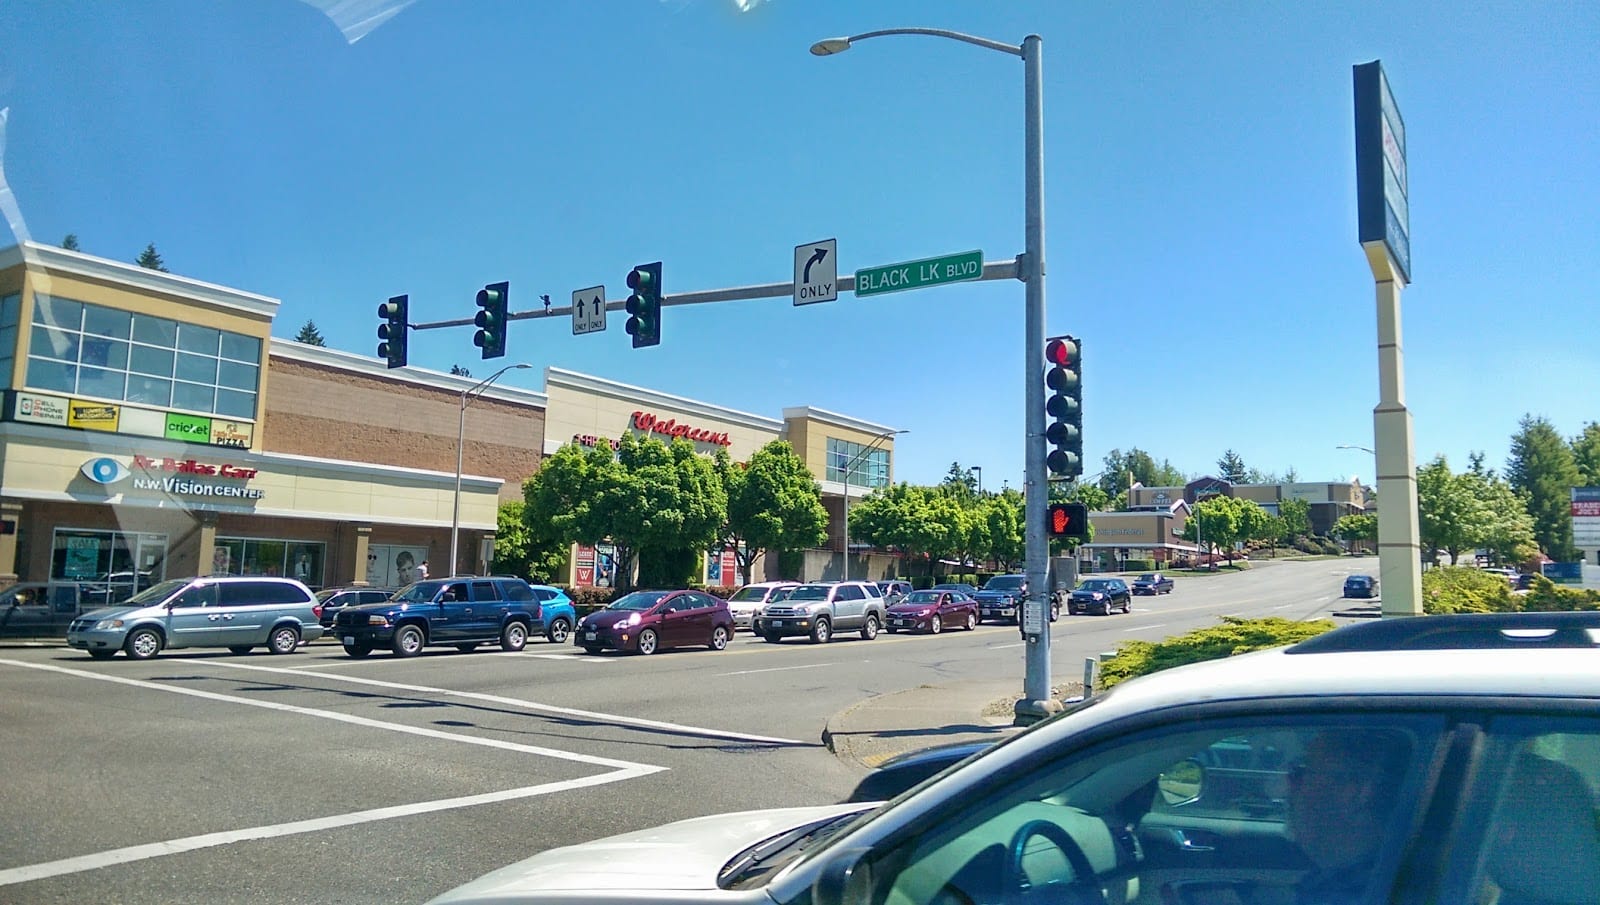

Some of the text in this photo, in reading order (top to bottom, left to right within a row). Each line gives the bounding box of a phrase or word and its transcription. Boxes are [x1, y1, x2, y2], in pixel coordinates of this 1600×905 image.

[859, 260, 977, 291] BLACK LK BLVD
[800, 283, 832, 299] ONLY
[575, 323, 587, 331] ONLY
[591, 320, 602, 329] ONLY
[33, 399, 55, 407] CELL
[33, 405, 63, 414] PHONE
[33, 411, 63, 420] REPAIR
[168, 422, 208, 435] cricket
[632, 411, 732, 447] Walgreens
[216, 437, 245, 448] PIZZA
[162, 457, 216, 476] Dallas
[220, 463, 258, 479] Carr
[134, 477, 265, 499] N.W. Vision CENTER
